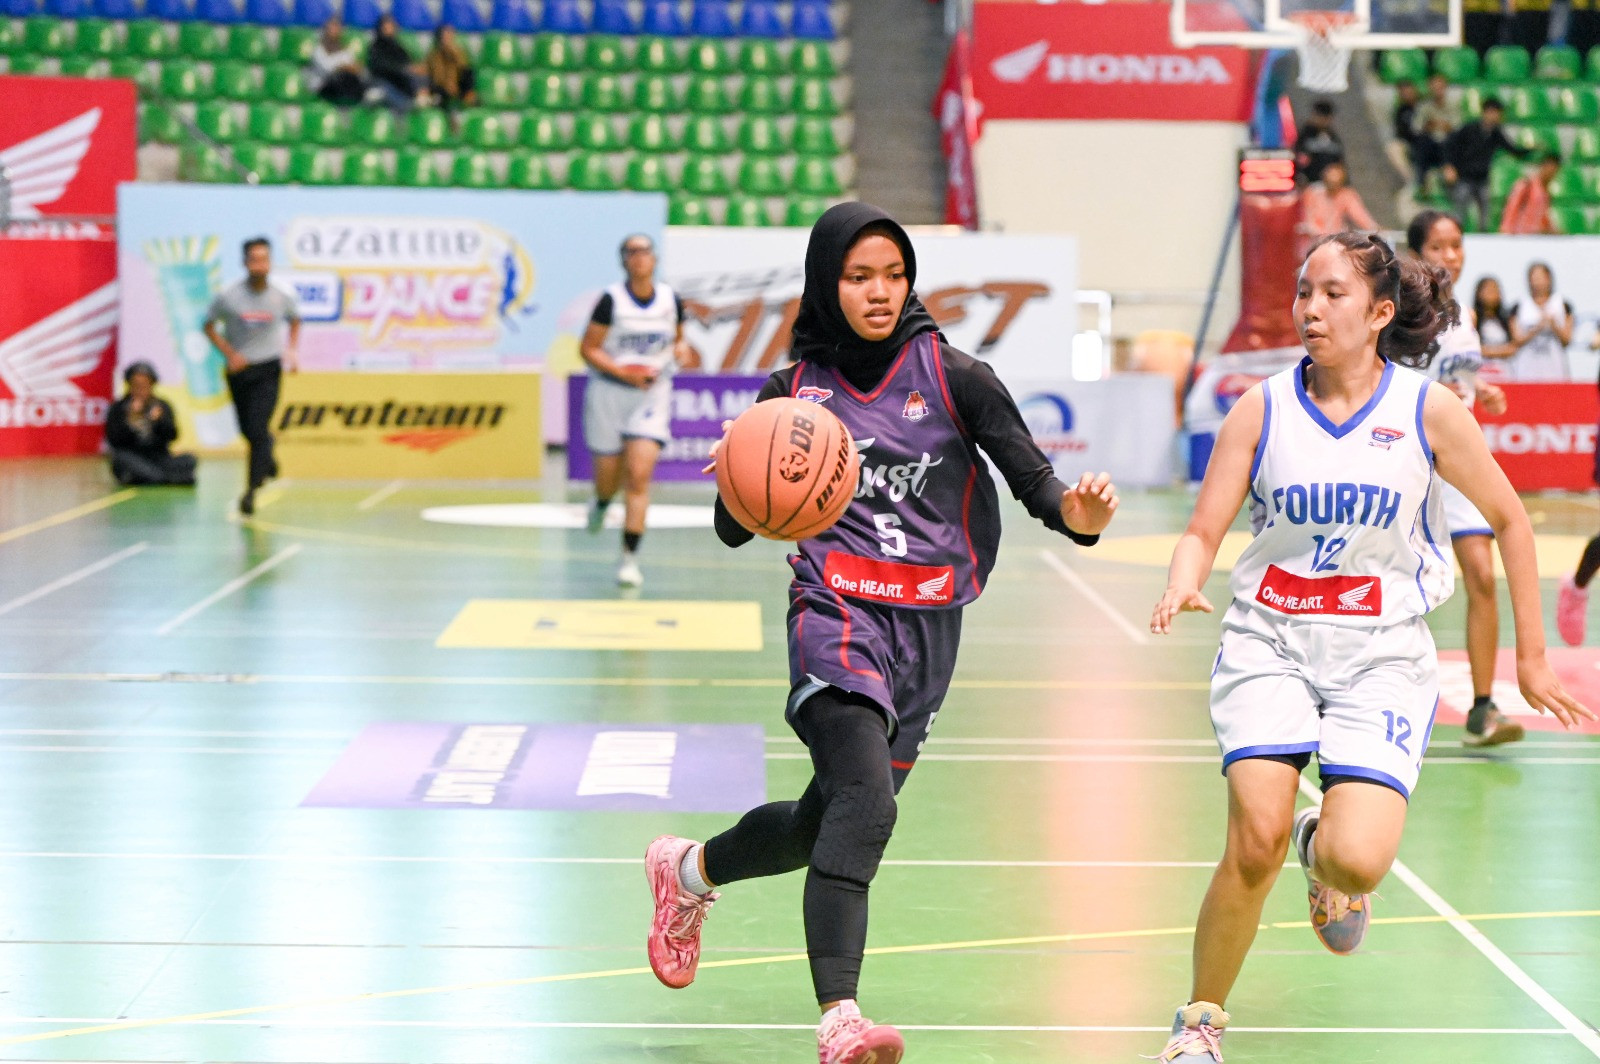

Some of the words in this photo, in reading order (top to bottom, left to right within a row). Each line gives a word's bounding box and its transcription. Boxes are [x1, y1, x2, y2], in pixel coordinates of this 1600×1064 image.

[1046, 54, 1232, 84] HONDA
[350, 273, 494, 338] DANCE
[0, 397, 109, 429] HOND
[278, 402, 507, 431] proteam
[872, 513, 908, 558] 5
[1310, 534, 1347, 573] 12
[831, 573, 858, 592] One
[859, 579, 904, 599] HEART.
[915, 593, 948, 601] HONDA
[1262, 586, 1285, 606] One
[1284, 595, 1324, 610] HEART.
[1337, 603, 1374, 611] HONDA
[1381, 709, 1413, 757] 12
